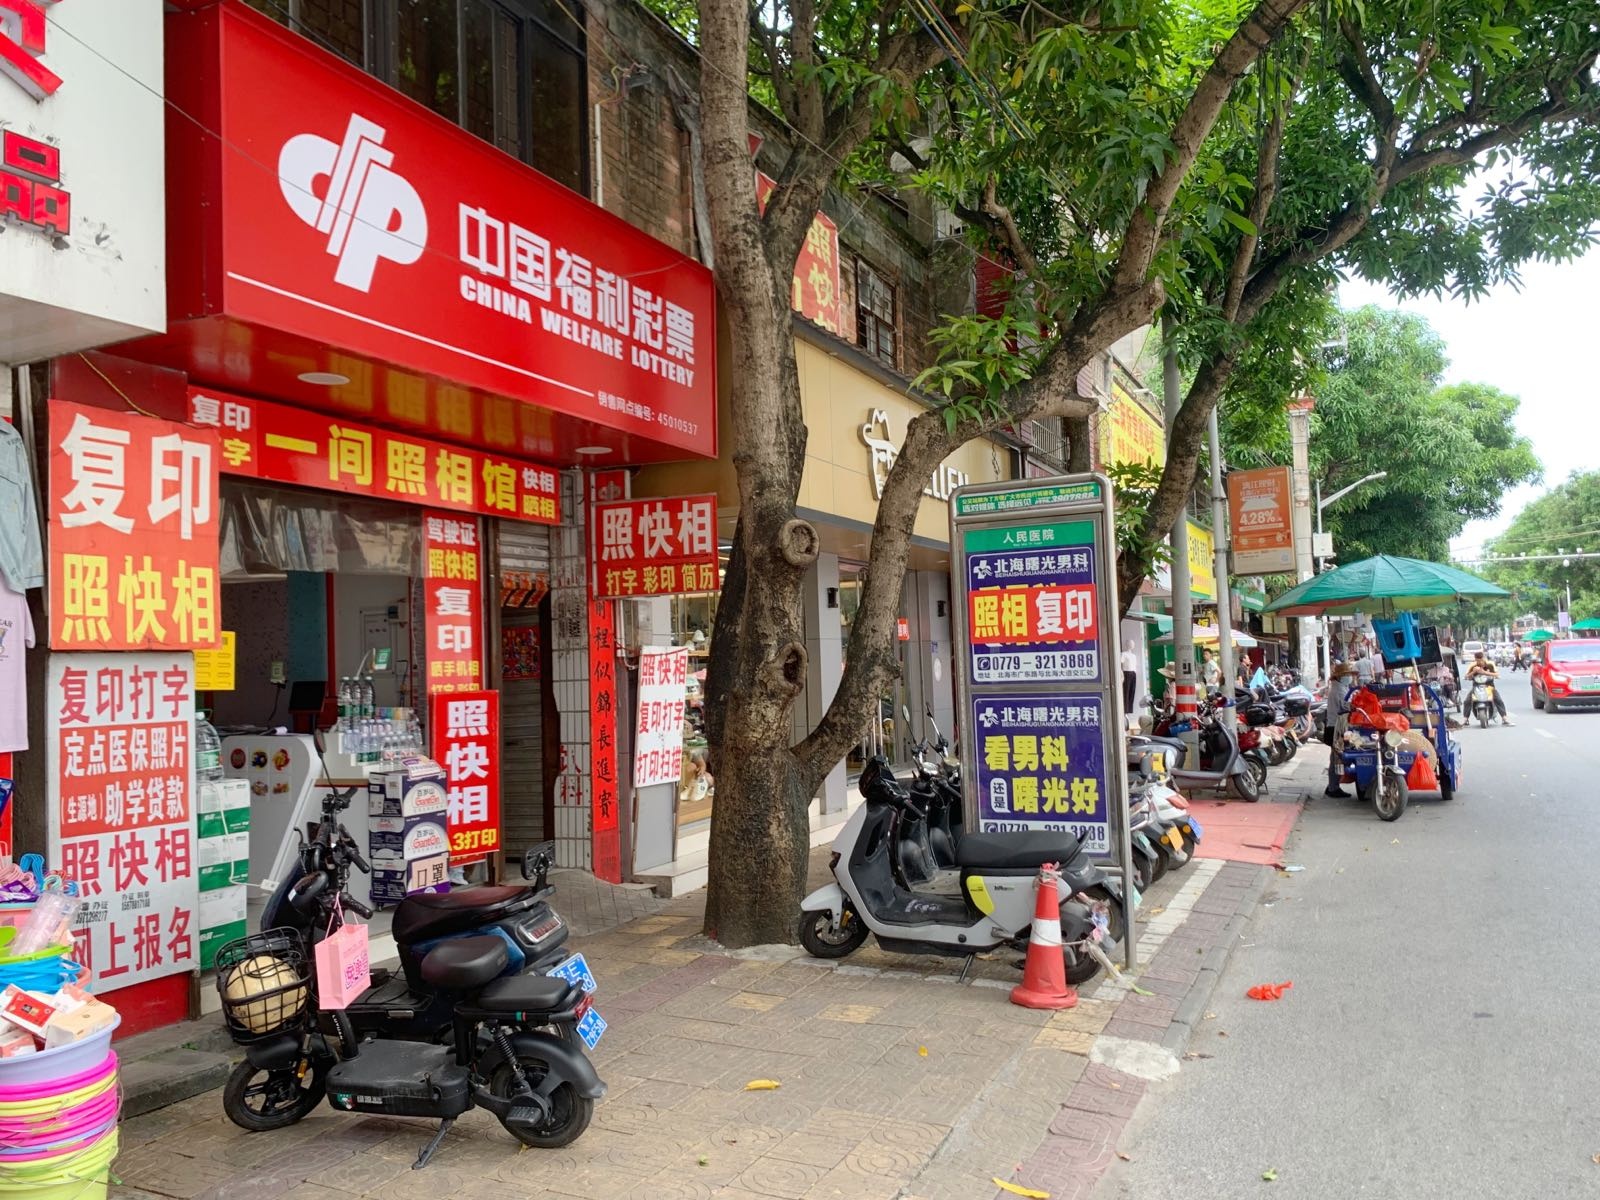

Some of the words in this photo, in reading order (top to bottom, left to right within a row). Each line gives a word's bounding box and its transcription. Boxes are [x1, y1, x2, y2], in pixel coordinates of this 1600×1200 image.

[459, 202, 695, 365] 中国福利彩票
[460, 275, 532, 324] CHINA
[540, 307, 624, 361] WELFARE
[631, 345, 695, 388] LOTTERY
[192, 394, 251, 432] 复印
[657, 414, 698, 436] 45010537
[59, 413, 211, 540] 复印
[265, 423, 517, 513] 一间照相馆
[523, 467, 555, 494] 快相
[523, 494, 555, 520] 晒相
[428, 517, 476, 546] 驾驶证
[601, 502, 713, 561] 照快相
[1003, 528, 1055, 543] 人民医院
[428, 548, 477, 581] 照快相
[606, 567, 638, 595] 打字
[643, 565, 676, 593] 彩印
[680, 562, 715, 589] 简历
[994, 553, 1089, 573] 北海曙光男科
[60, 552, 216, 644] 照快相
[973, 594, 1029, 638] 照相
[1035, 590, 1093, 636] 复印
[435, 587, 473, 653] 复印
[641, 653, 687, 687] 照快相
[59, 664, 189, 725] 复印打字
[639, 698, 684, 736] 复印打字
[1001, 706, 1099, 722] 北海曙光男科
[64, 725, 187, 778] 定点医保照片
[445, 700, 490, 826] 照快相
[636, 746, 682, 785] 打印扫描
[984, 735, 1070, 772] 看男科
[993, 782, 1006, 809] 还是
[1012, 776, 1099, 815] 曙光好
[61, 828, 192, 898] 照快相
[417, 863, 444, 888] 口罩
[70, 906, 193, 980] 网上报名
